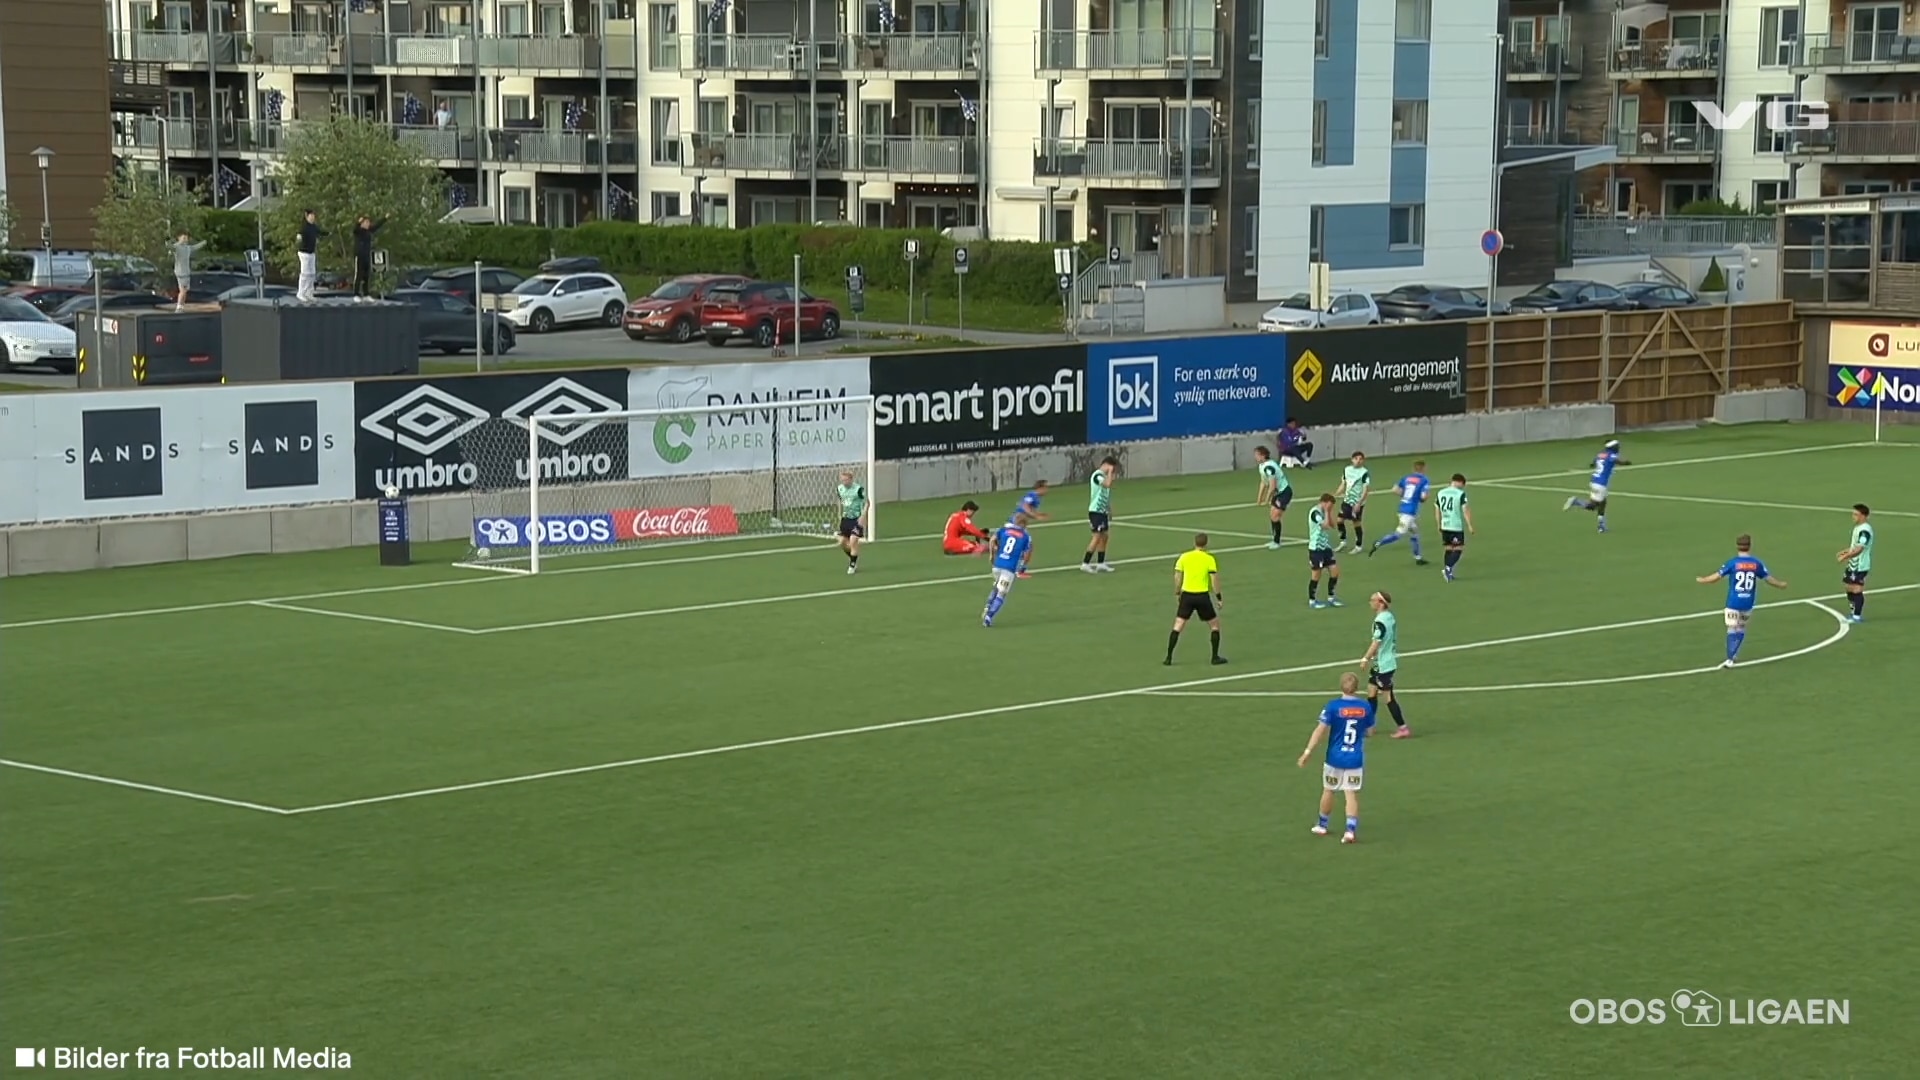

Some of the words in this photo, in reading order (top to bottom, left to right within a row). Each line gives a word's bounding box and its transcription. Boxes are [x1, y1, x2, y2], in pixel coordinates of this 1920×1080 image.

[1174, 367, 1193, 382] For
[1197, 368, 1211, 381] en
[1213, 363, 1241, 380] sterk
[1242, 365, 1257, 381] og
[1331, 362, 1369, 383] Aktiv
[1373, 356, 1459, 382] Arrangement
[875, 381, 985, 426] smart
[992, 368, 1084, 431] profil
[1115, 372, 1152, 409] bk
[1173, 386, 1205, 407] synlig
[1208, 385, 1271, 401] merkevare.
[228, 434, 334, 455] SANDS
[707, 433, 764, 450] PAPER
[789, 428, 846, 446] BOARD
[64, 443, 179, 464] SANDS
[516, 449, 611, 480] umbro
[375, 458, 478, 491] umbro
[1441, 496, 1454, 512] 24
[525, 518, 609, 543] OBOS
[632, 507, 710, 537] Coca-Cola
[1003, 536, 1017, 554] 8
[1735, 571, 1755, 591] 26
[1344, 719, 1358, 745] 5
